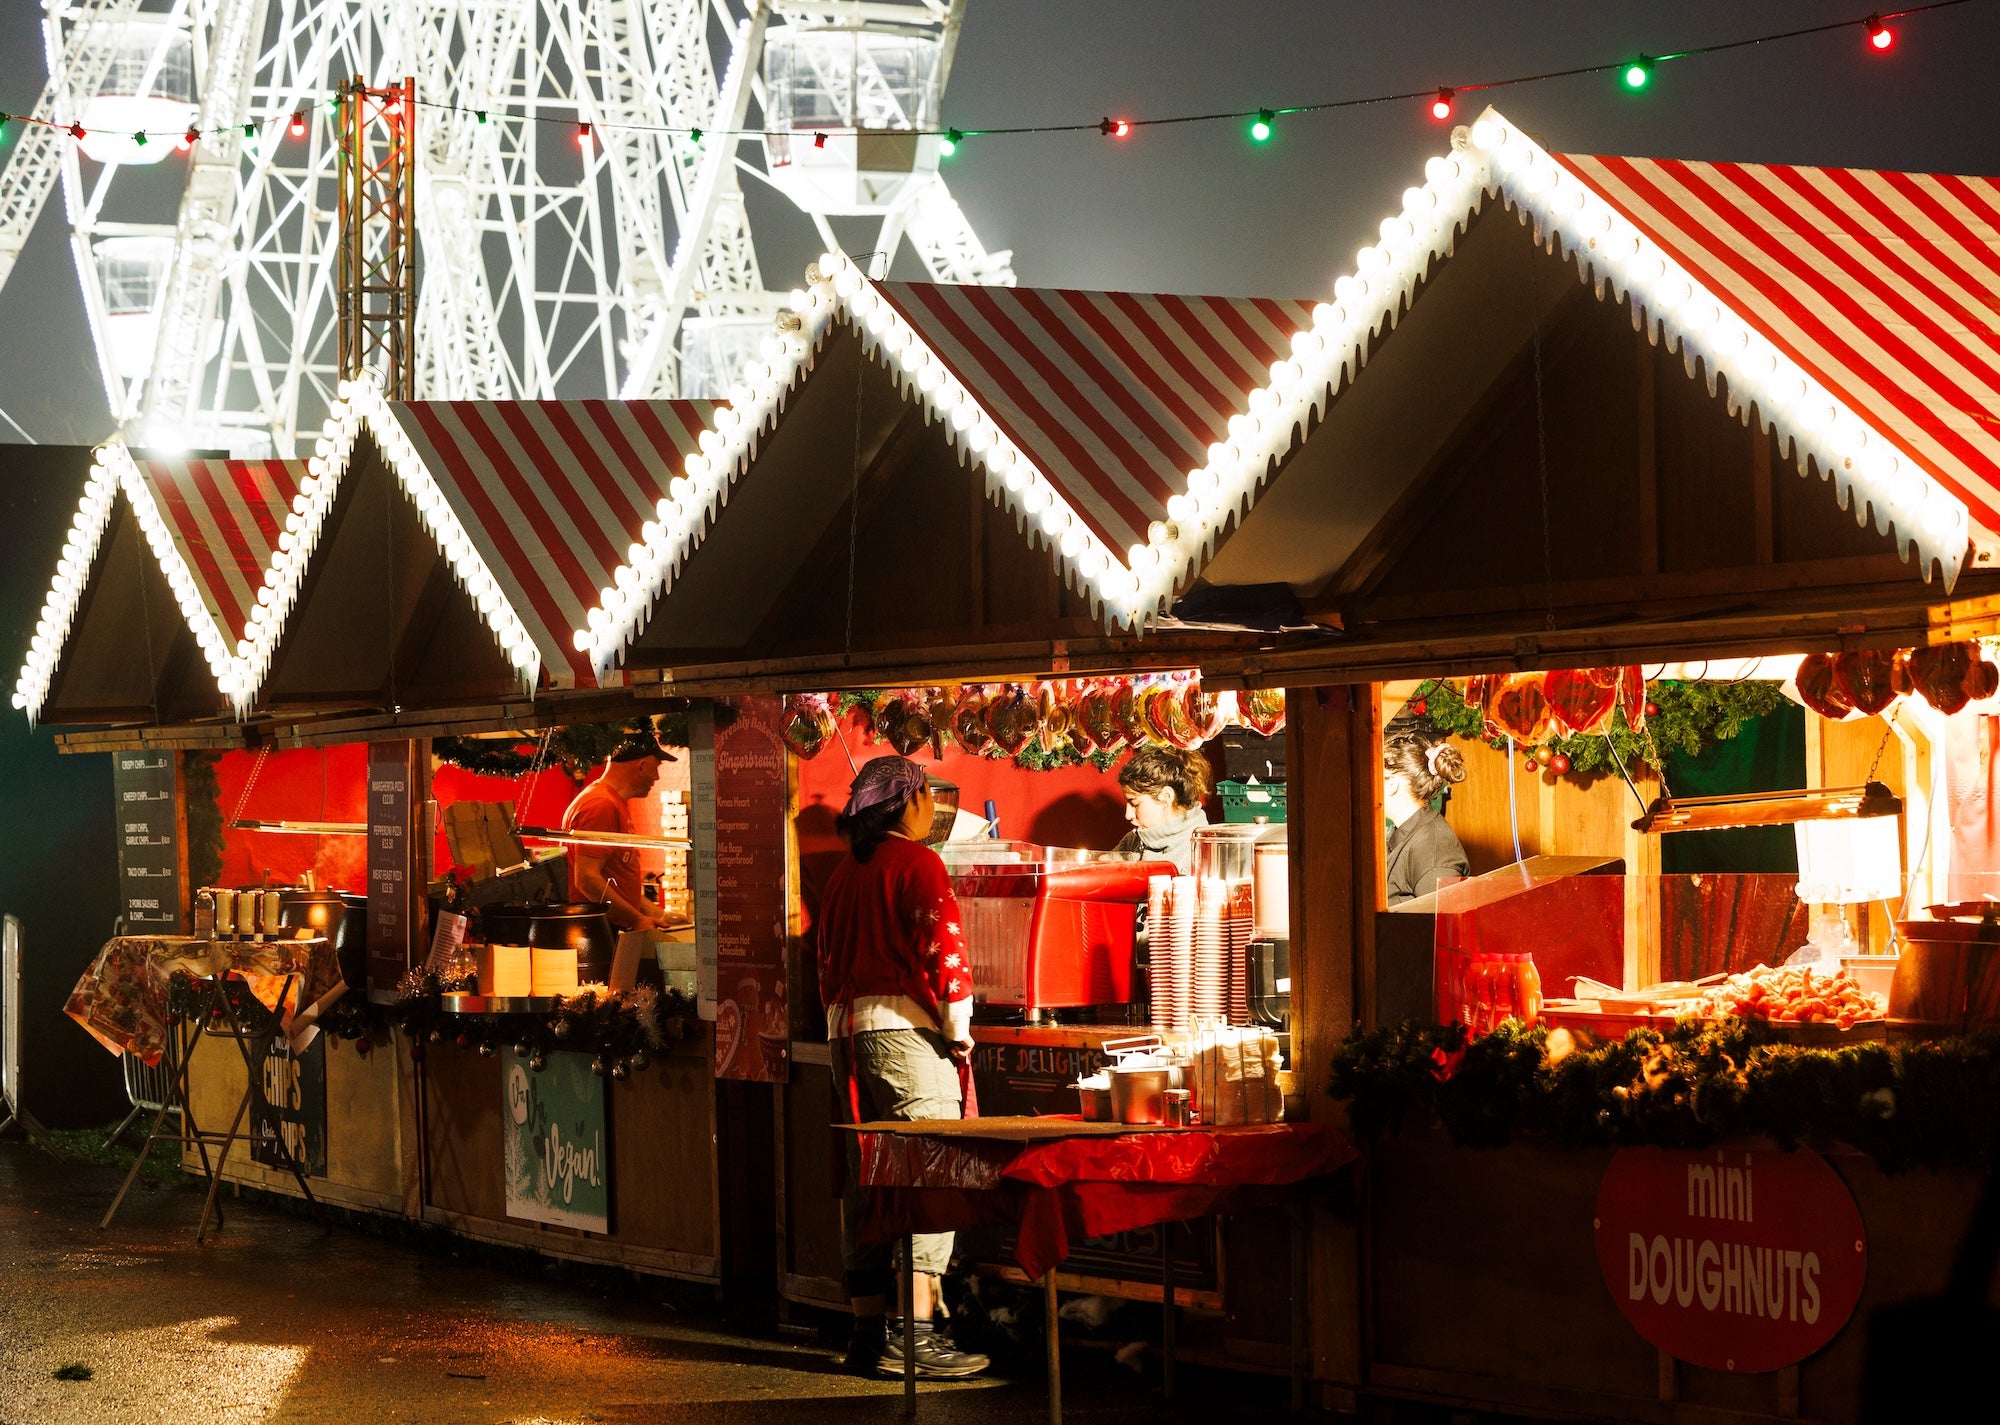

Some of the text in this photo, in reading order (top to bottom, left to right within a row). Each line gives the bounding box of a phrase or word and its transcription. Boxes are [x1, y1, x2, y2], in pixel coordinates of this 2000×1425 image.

[718, 750, 777, 776] Gingerbread
[717, 797, 735, 808] Xmas
[735, 797, 750, 808] Heart
[718, 821, 750, 833] Gingerman
[718, 842, 728, 853] Mix
[729, 842, 743, 855] Bags
[718, 853, 754, 867] Gingerbread
[718, 876, 738, 887] Cookie
[718, 911, 742, 921] Brownie
[718, 934, 738, 946] Belgian
[739, 934, 750, 945] Hot
[718, 945, 747, 956] Chocolate
[973, 1047, 1008, 1073] AFE
[263, 1055, 302, 1111] CHIPS
[280, 1120, 307, 1164] DIPS
[545, 1122, 601, 1205] Vegan!
[1687, 1150, 1753, 1223] mini
[1629, 1231, 1820, 1325] DOUGHNUTS
